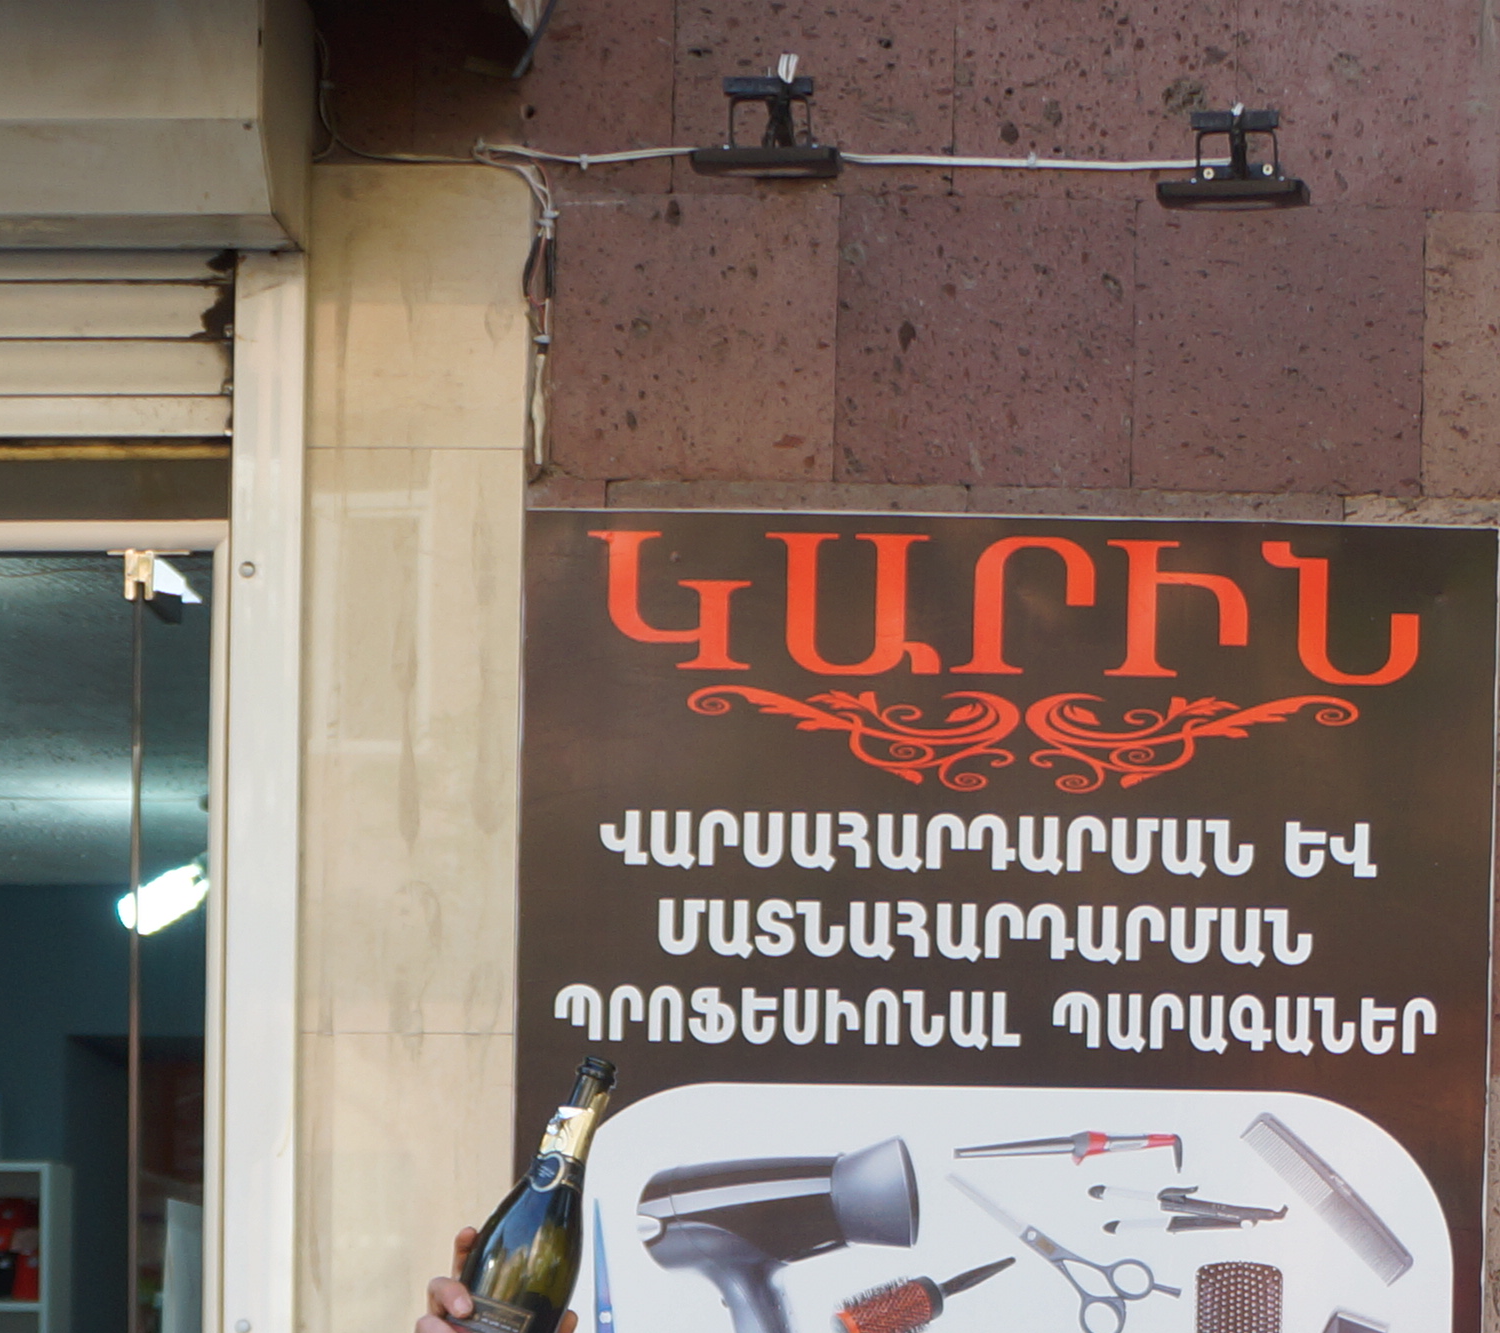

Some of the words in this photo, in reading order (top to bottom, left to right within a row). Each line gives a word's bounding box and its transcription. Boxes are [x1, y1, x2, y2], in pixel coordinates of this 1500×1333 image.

[587, 531, 1421, 686] ԿԱՐԻՆ
[599, 809, 1254, 878] ՎԱՐՍԱՀԱՐԴԱՐՄԱՆ
[1285, 821, 1378, 879] ԵՎ
[658, 898, 1313, 968] ՄԱՏՆԱՀԱՐԴԱՐՄԱՆ
[554, 983, 1022, 1051] ՊՐՈՖԵՍԻՈՆԱԼ
[1052, 990, 1438, 1056] ՊԱՐԱԳԱՆԵՐ
